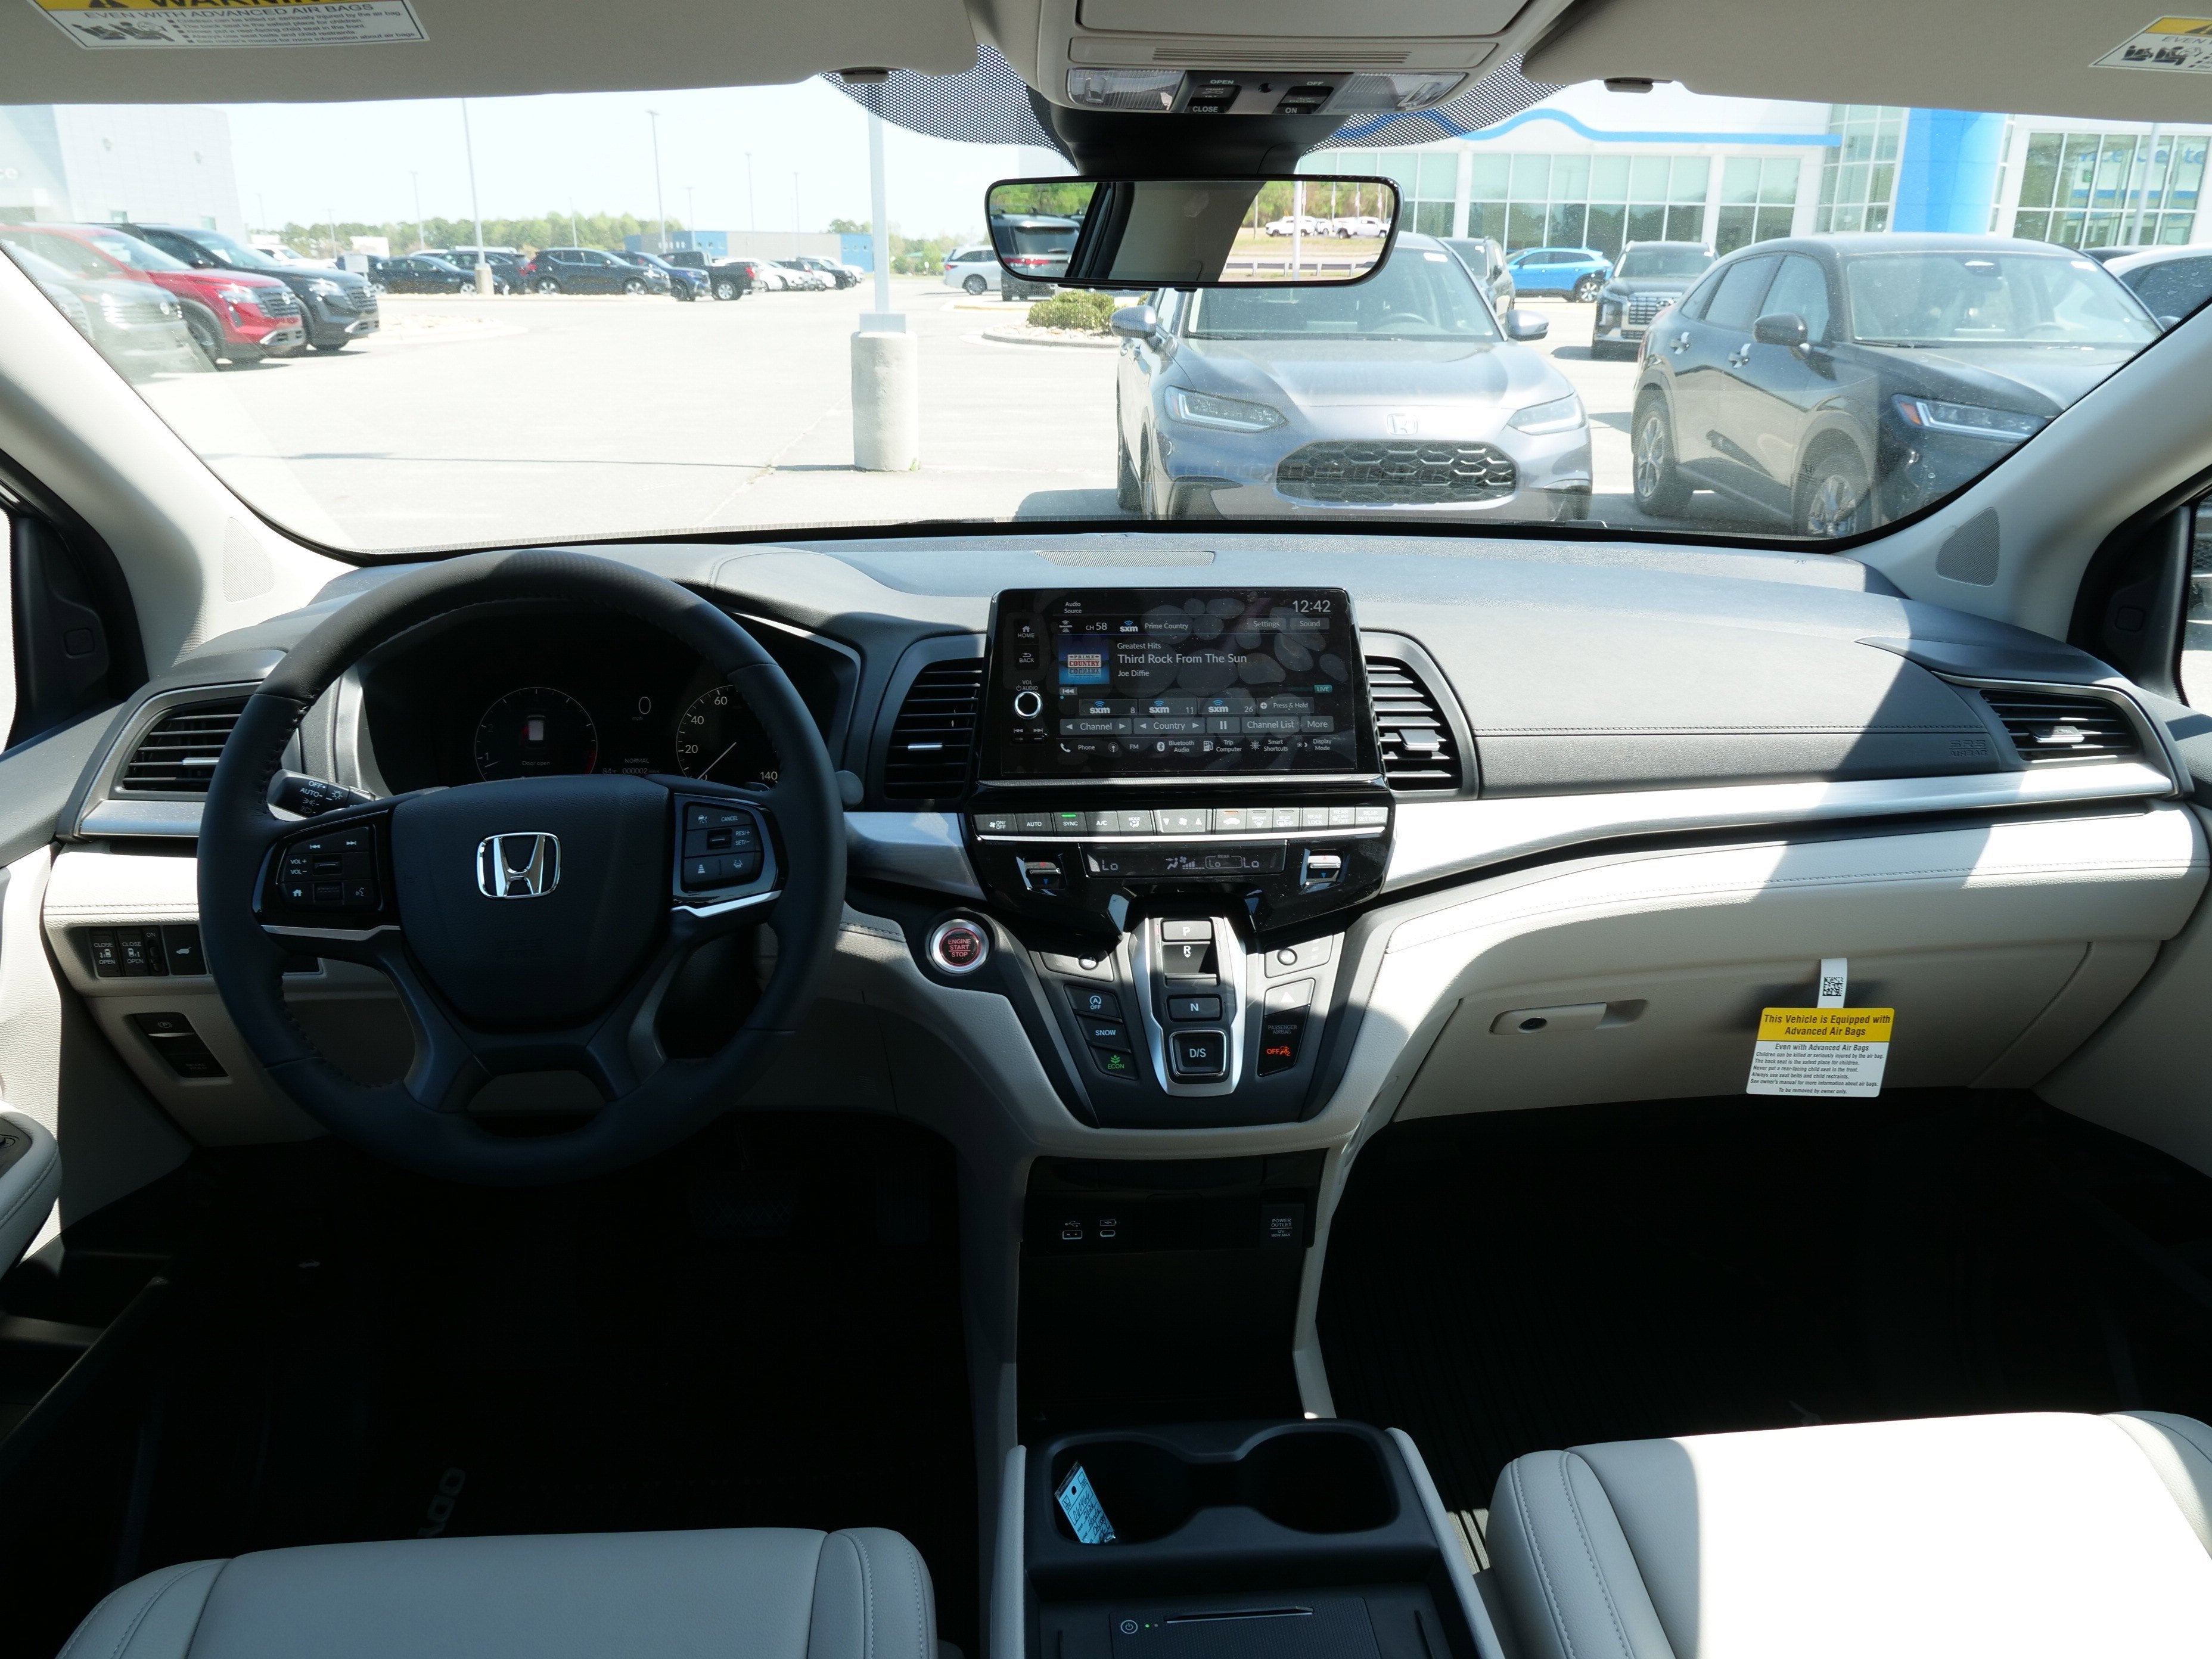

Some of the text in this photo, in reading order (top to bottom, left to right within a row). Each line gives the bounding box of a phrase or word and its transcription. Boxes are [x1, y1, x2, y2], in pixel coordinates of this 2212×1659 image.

[191, 8, 287, 17] ADVANCED
[324, 4, 374, 13] BAGS
[1292, 600, 1331, 613] 12:42
[1096, 622, 1108, 630] 58
[1117, 654, 1247, 664] Third Rock From The Sun
[638, 696, 651, 714] 0
[714, 696, 728, 706] 60
[691, 716, 704, 725] 40
[1247, 720, 1279, 729] Channel
[1080, 722, 1113, 731] Channel
[1153, 722, 1186, 731] Country
[685, 744, 698, 754] 20
[1950, 740, 1986, 748] SRS
[760, 771, 778, 781] 140
[300, 787, 320, 797] AUTO
[1183, 927, 1191, 936] P
[1183, 946, 1191, 954] R
[1191, 1003, 1199, 1012] N
[1764, 1014, 1782, 1023] This
[1785, 1015, 1818, 1023] Vehicle
[1831, 1015, 1871, 1025] Equipped
[1873, 1015, 1891, 1024] with
[1785, 1026, 1866, 1037] Advanced Air Bags
[1189, 1048, 1206, 1058] D/S
[1853, 1044, 1869, 1052] Bags
